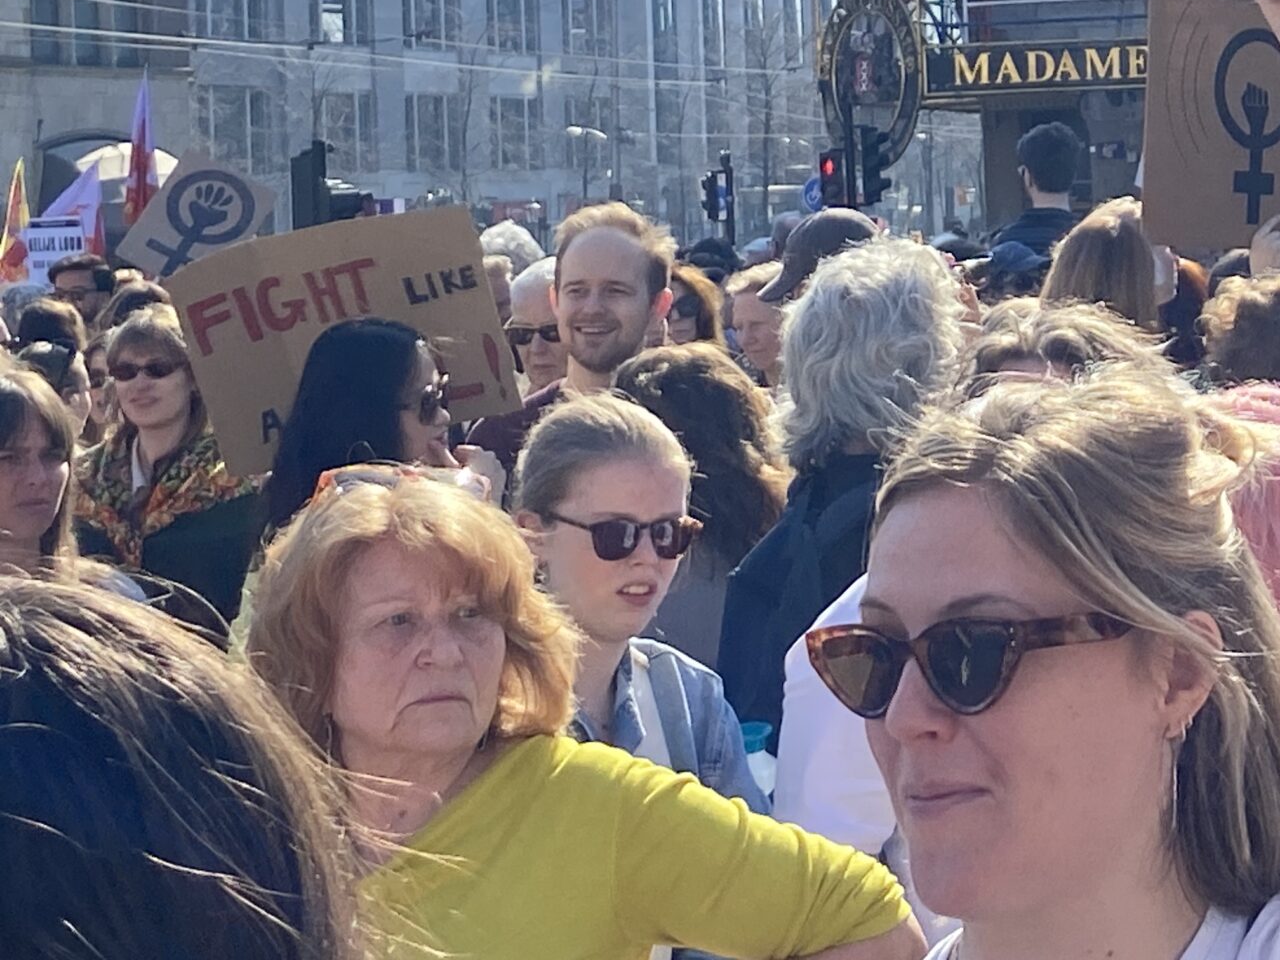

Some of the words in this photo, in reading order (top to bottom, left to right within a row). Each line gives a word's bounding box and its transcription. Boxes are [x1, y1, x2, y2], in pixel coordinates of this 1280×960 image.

[953, 45, 1148, 86] MADAME
[186, 257, 377, 358] FIGHT
[402, 264, 479, 306] LIKE
